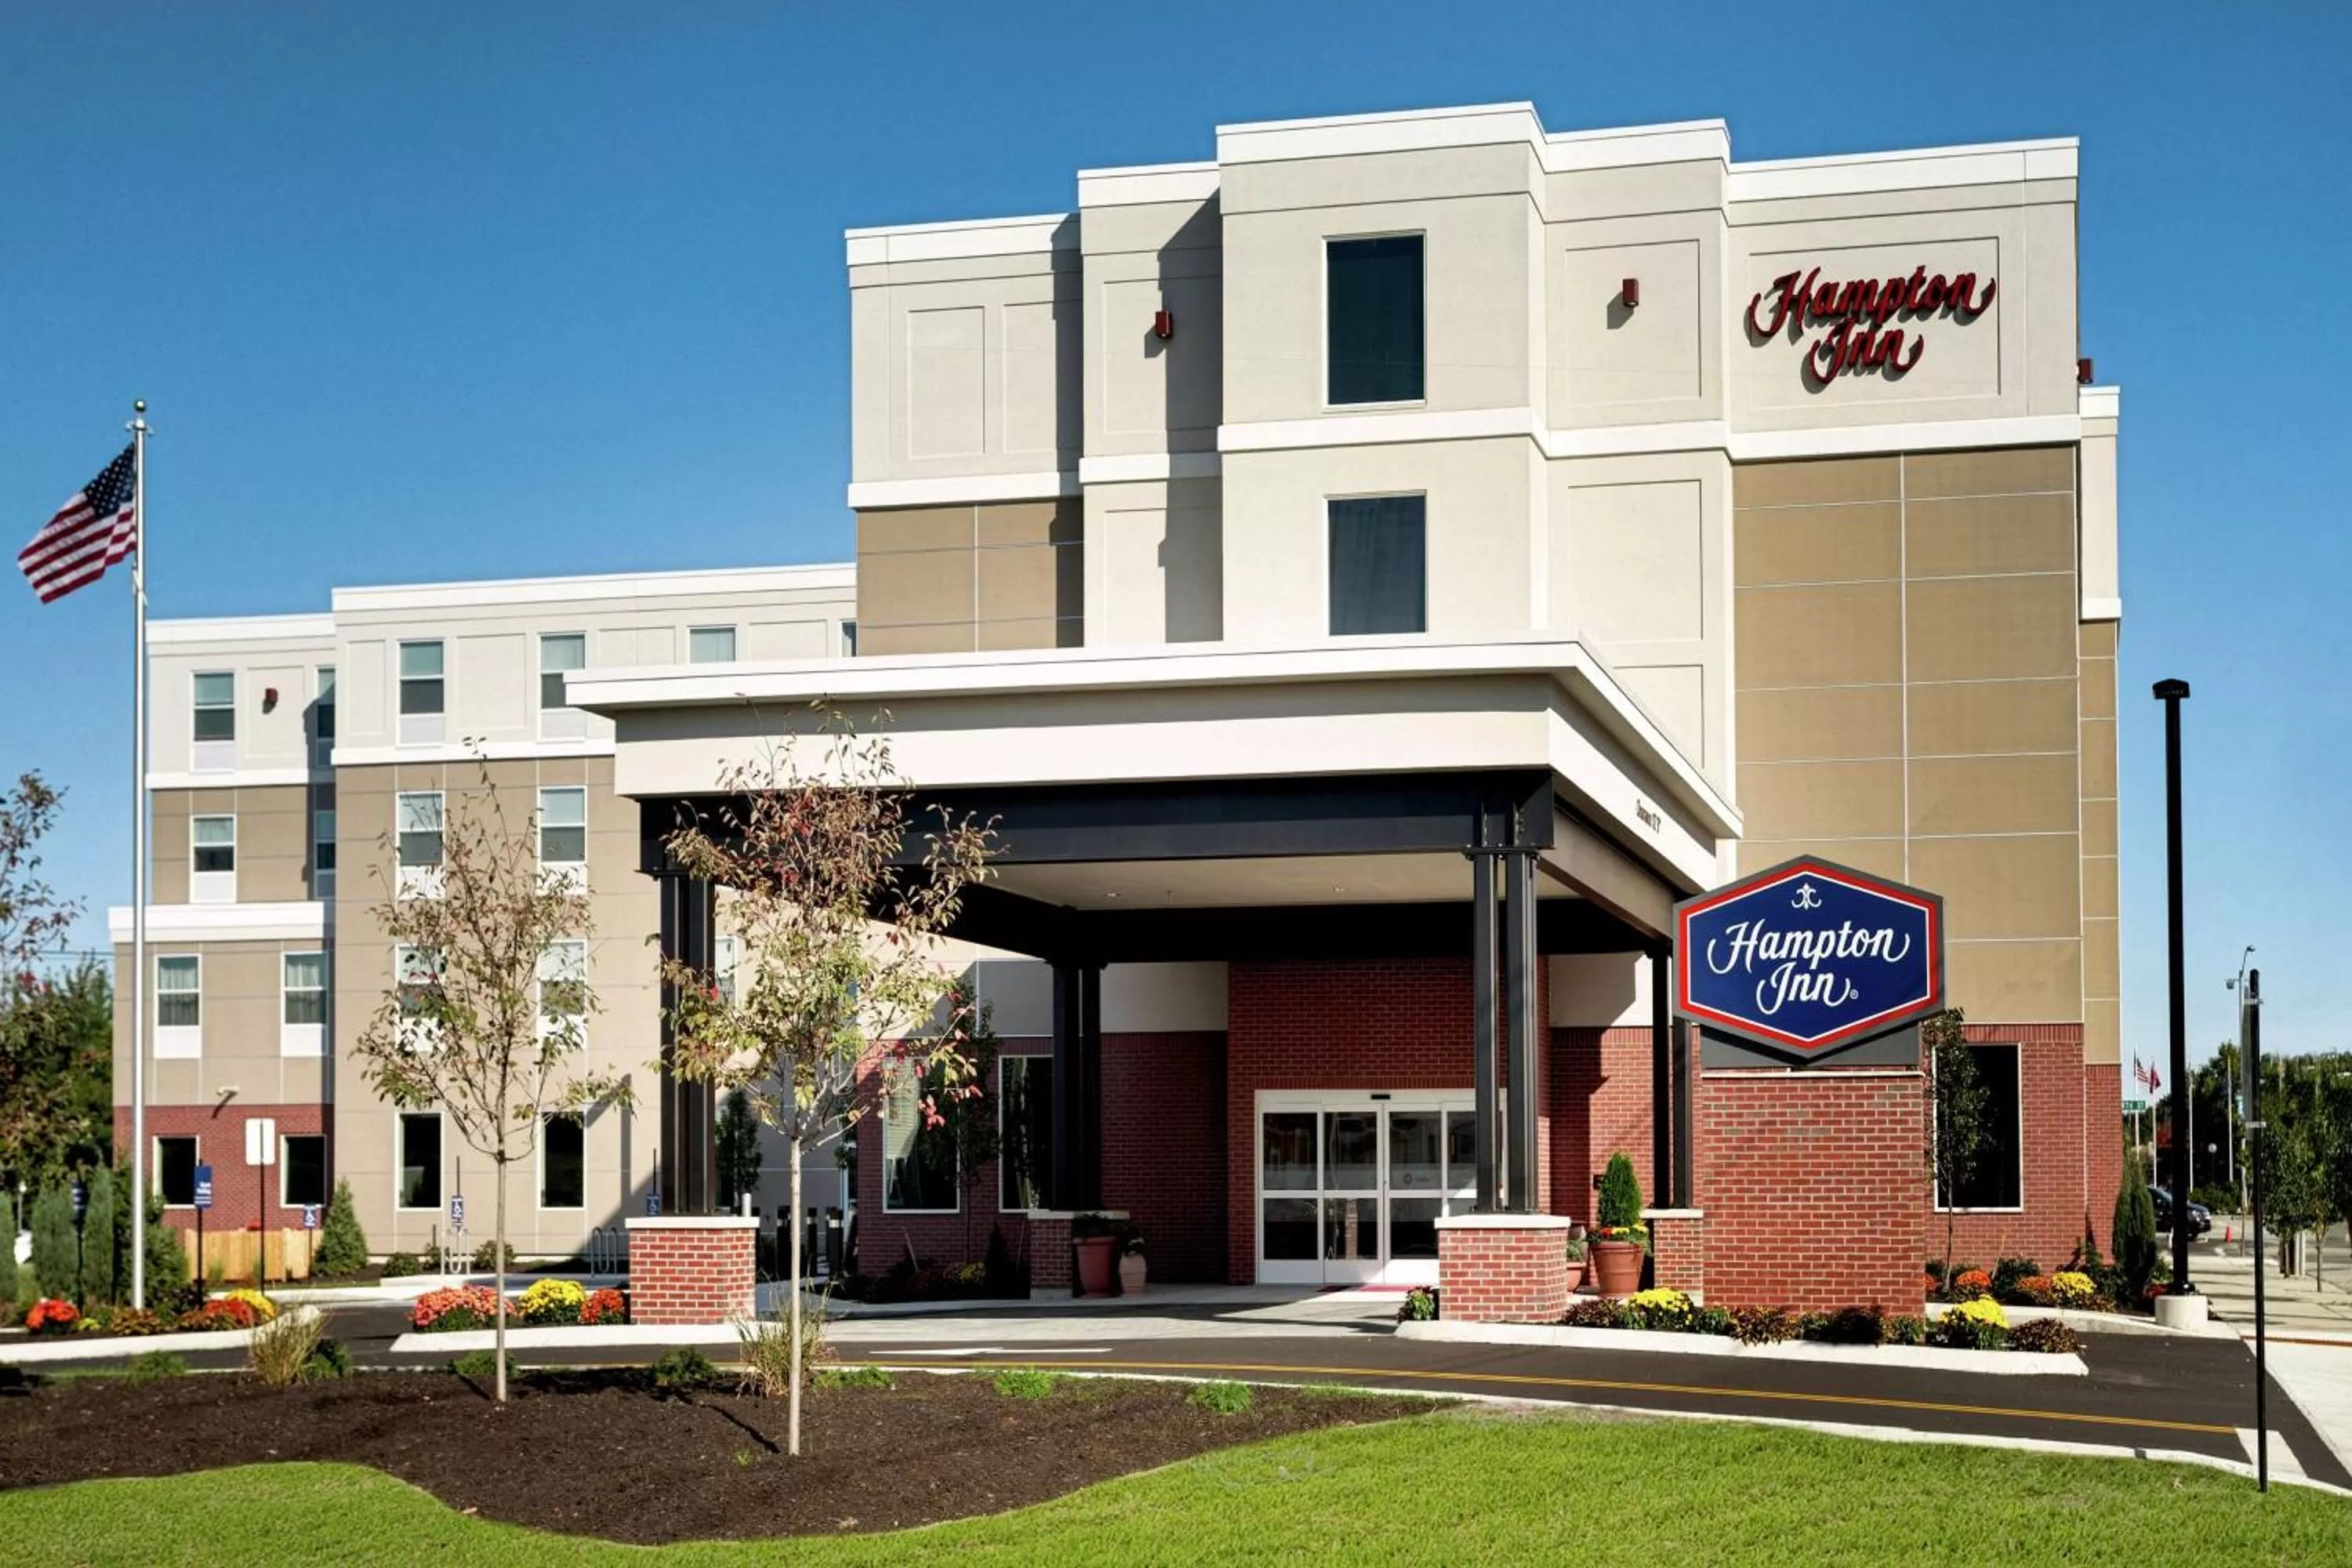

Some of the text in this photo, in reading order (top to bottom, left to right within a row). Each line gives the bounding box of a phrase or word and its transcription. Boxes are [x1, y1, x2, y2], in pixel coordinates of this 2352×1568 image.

[1749, 265, 1997, 338] Hampton
[1809, 316, 1925, 385] Inn
[1706, 918, 1911, 975] Hampton
[1755, 961, 1851, 1015] Inn
